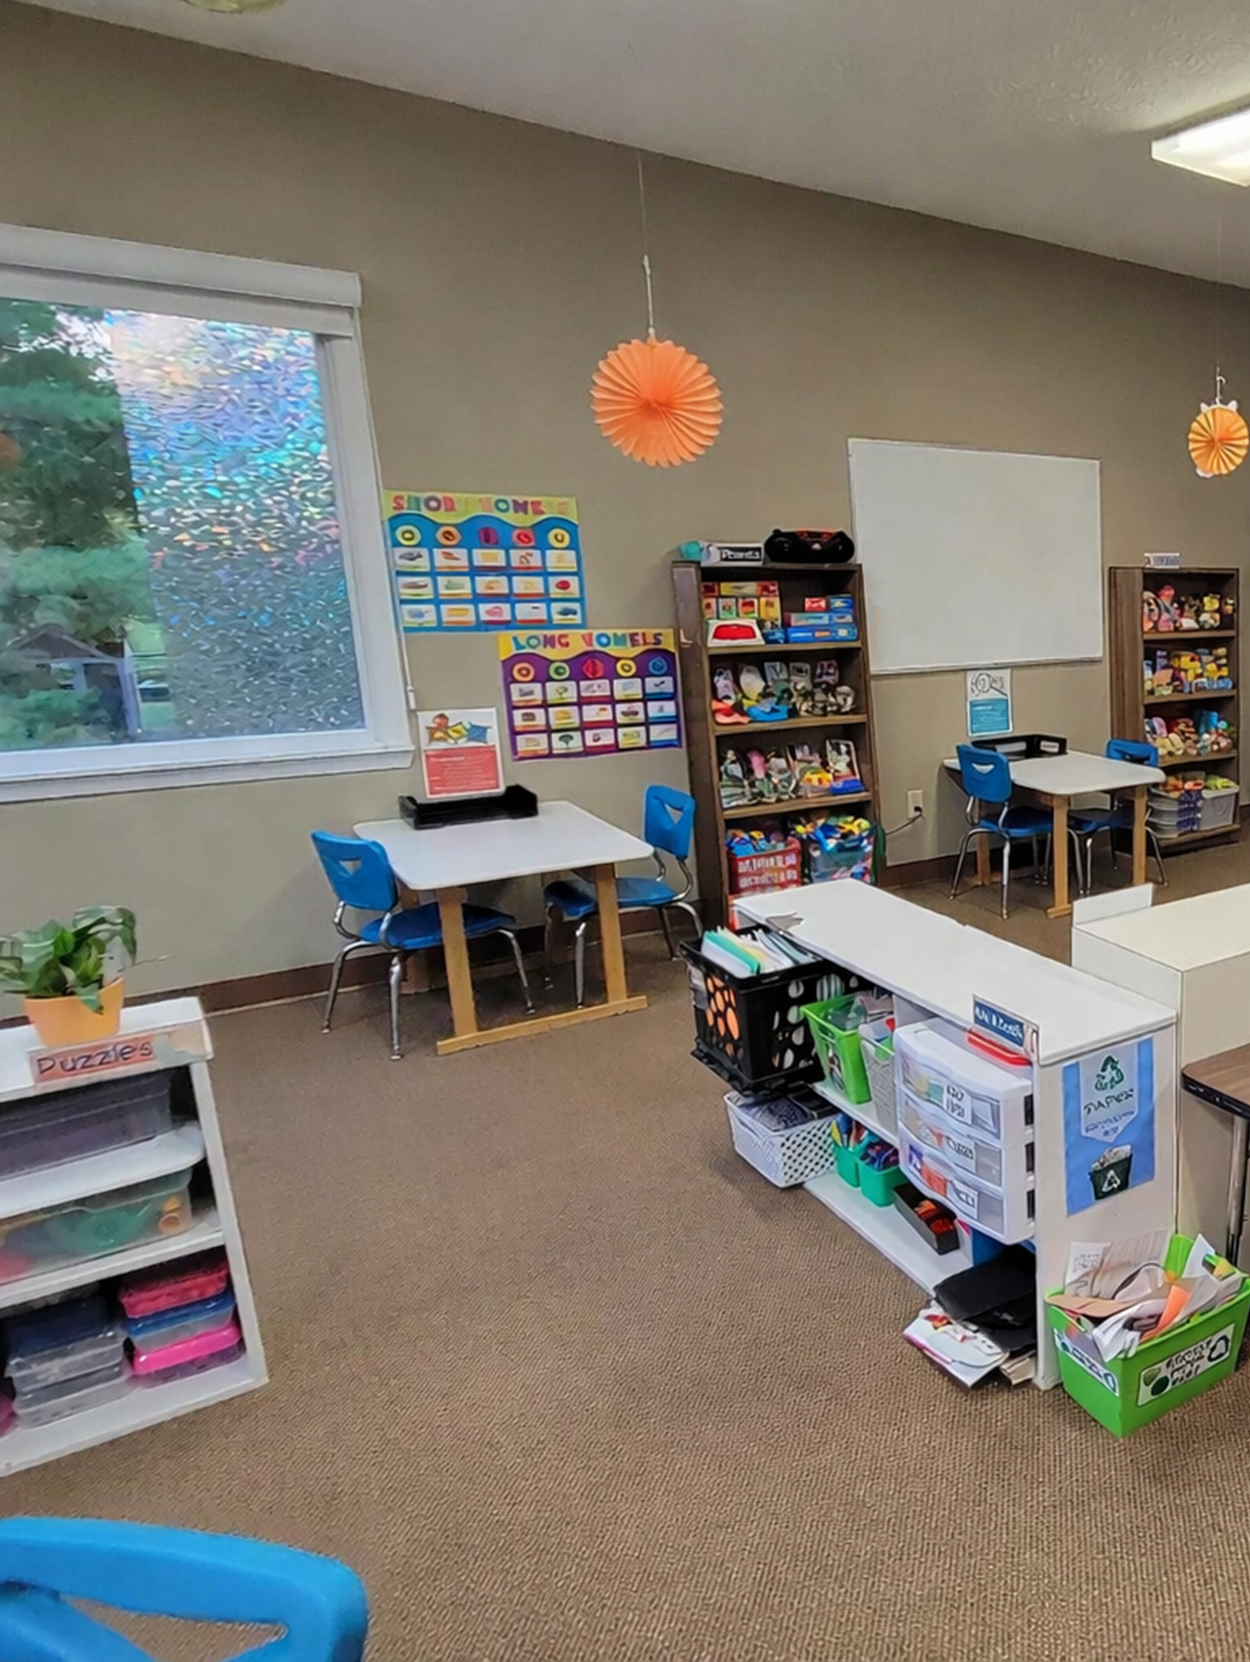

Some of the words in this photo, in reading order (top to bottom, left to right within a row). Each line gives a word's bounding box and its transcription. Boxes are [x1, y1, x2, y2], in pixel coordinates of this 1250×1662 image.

[392, 495, 471, 513] SHOR
[479, 497, 569, 516] VOWES
[511, 633, 570, 651] LONG
[581, 632, 664, 648] VOWELS
[36, 1041, 152, 1075] Puzzles
